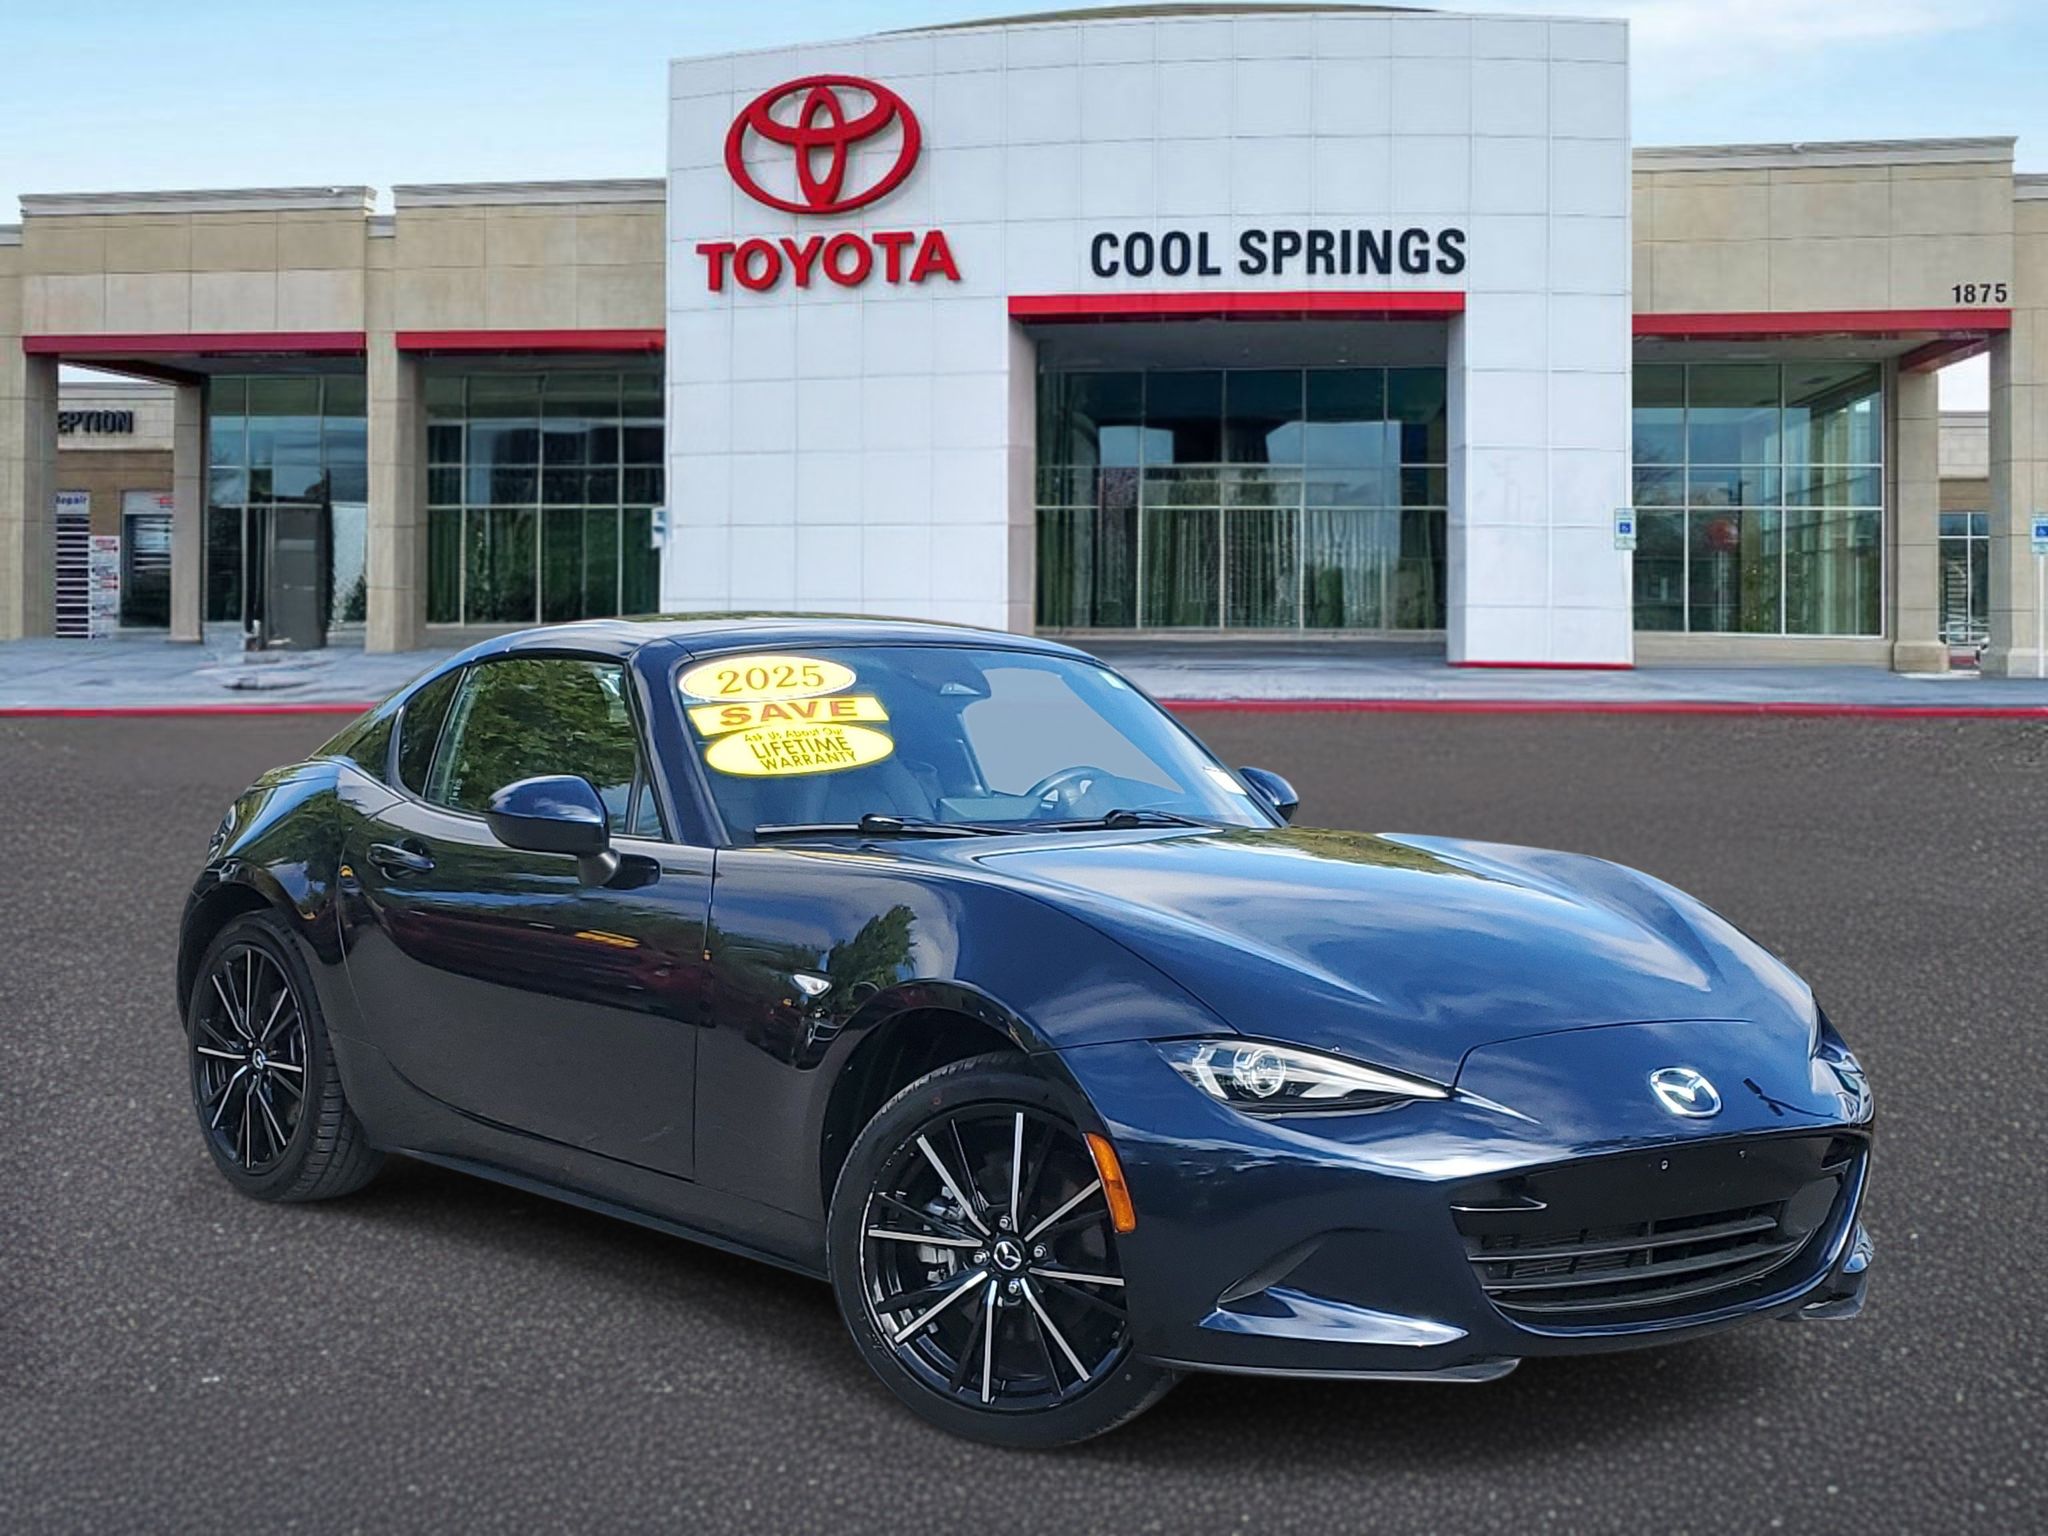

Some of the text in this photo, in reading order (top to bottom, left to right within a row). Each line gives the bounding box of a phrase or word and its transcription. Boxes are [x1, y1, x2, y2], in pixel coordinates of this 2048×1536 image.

[695, 230, 961, 292] TOYOTA
[1090, 228, 1466, 278] COOL SPRINGS
[1951, 283, 2007, 304] 1875
[717, 665, 824, 694] 2025
[720, 700, 858, 726] SAVE
[751, 737, 851, 759] LIFETIME
[760, 751, 857, 771] WARRANTY
